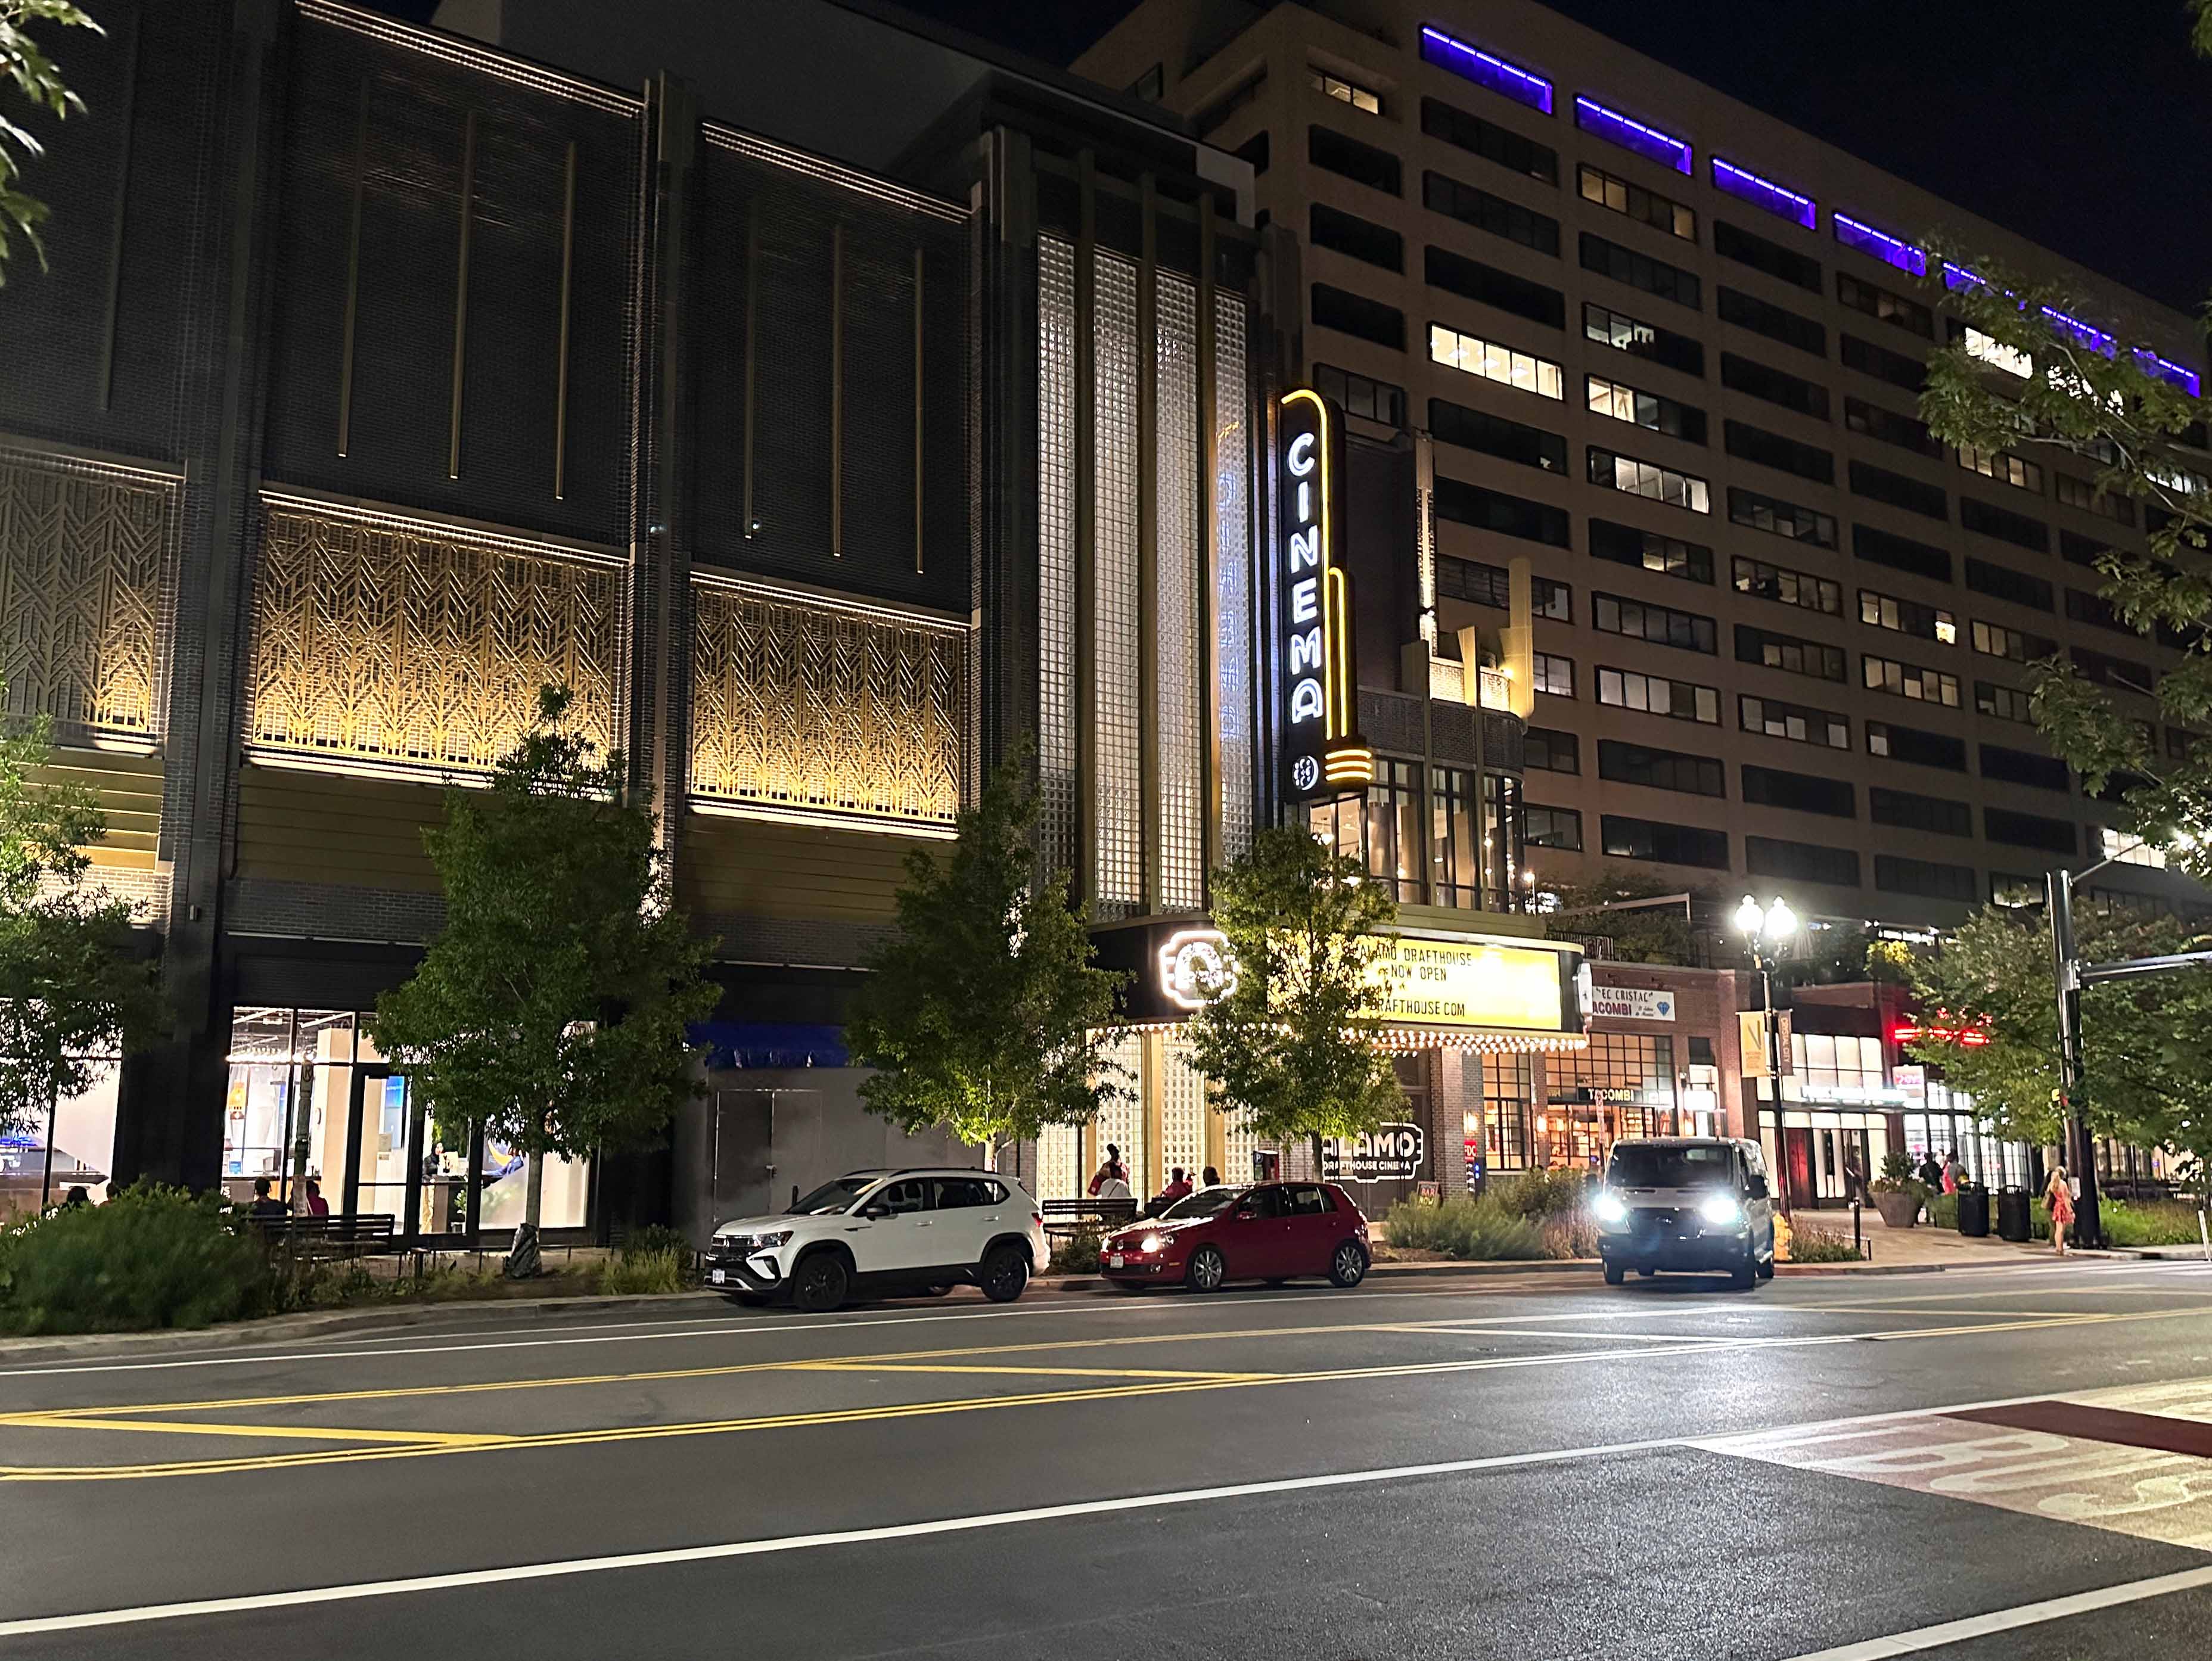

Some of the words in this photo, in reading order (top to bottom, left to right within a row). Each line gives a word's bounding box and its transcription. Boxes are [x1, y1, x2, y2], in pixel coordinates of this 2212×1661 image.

[1287, 432, 1324, 724] CINEMA
[1404, 948, 1472, 966] DRAFTHOUSE
[1391, 964, 1412, 978] NOW
[1420, 966, 1447, 981] OPEN
[1371, 999, 1440, 1015] RAFTHOUSE
[1592, 1001, 1632, 1016] ACOMBI
[1781, 1017, 1789, 1047] CRYSTAL
[1322, 1131, 1415, 1158] ALAMO
[1324, 1161, 1378, 1171] DRAFTHOUSE
[1421, 1188, 1435, 1197] BAR
